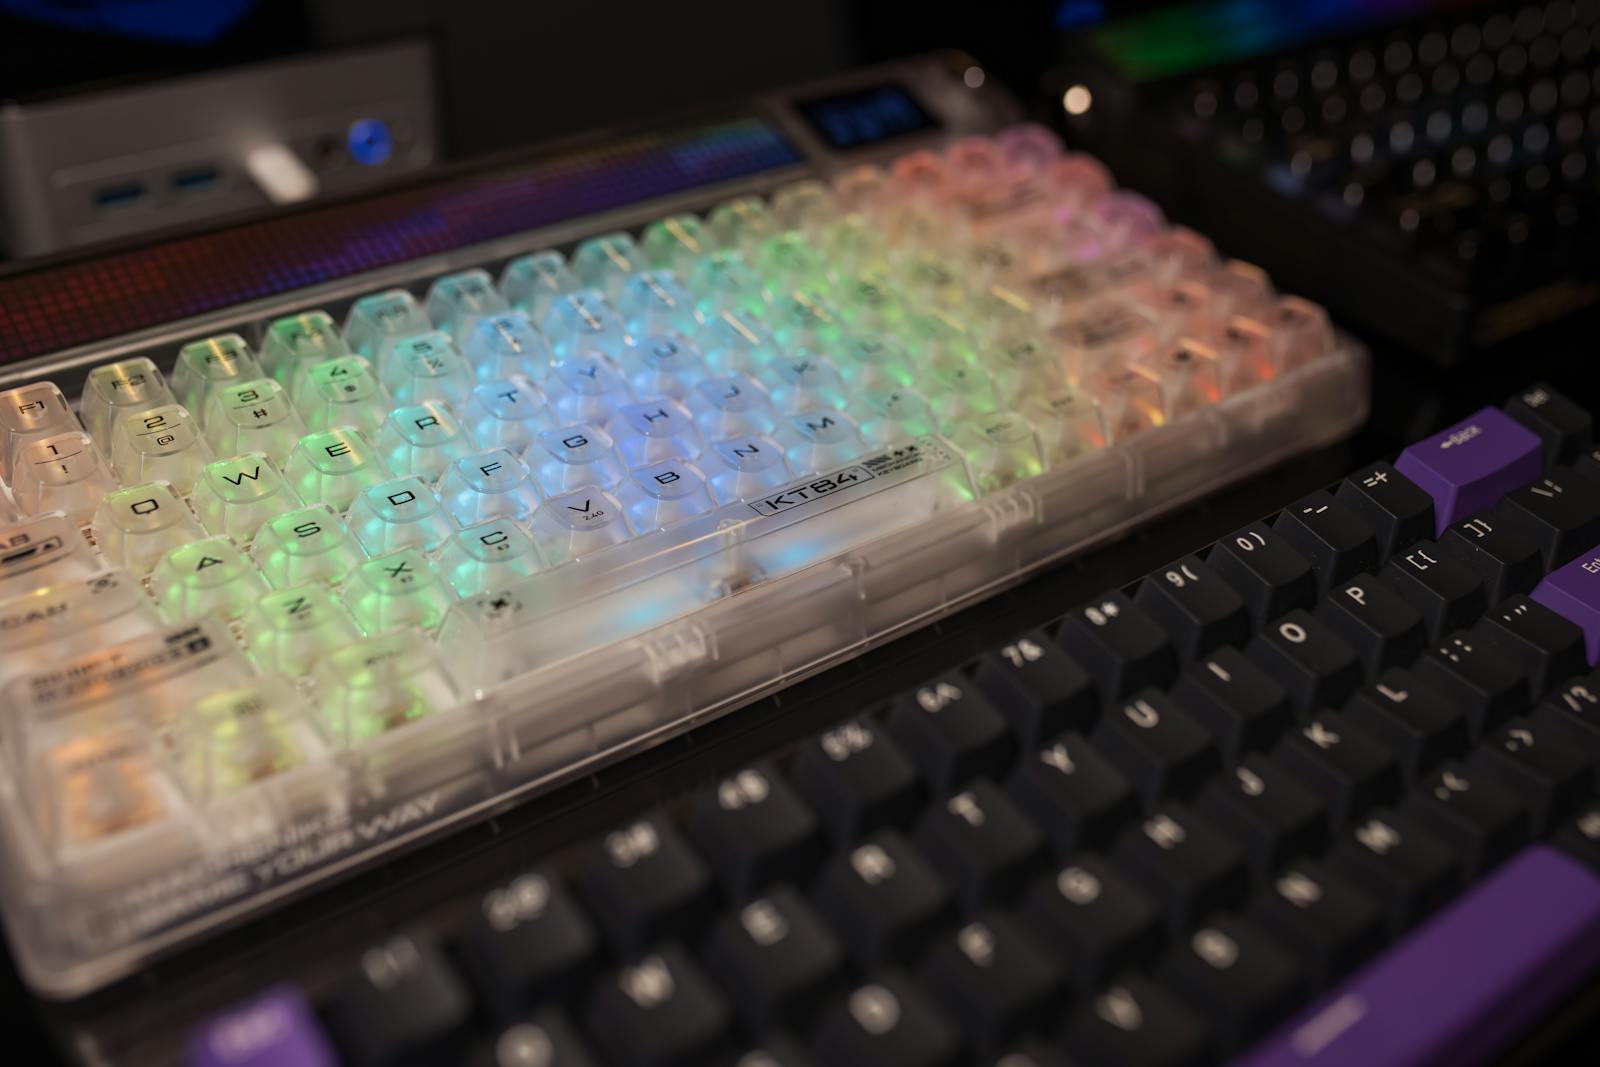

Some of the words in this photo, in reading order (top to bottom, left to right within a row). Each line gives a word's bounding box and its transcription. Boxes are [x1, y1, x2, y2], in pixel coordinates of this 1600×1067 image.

[237, 390, 259, 402] 3
[498, 389, 519, 403] T
[19, 400, 45, 415] F1
[144, 416, 166, 429] 2
[415, 415, 440, 430] R
[643, 409, 669, 424] H
[806, 416, 836, 432] M
[157, 434, 174, 446] @
[562, 435, 588, 449] G
[47, 445, 58, 455] 1
[325, 442, 351, 458] E
[733, 444, 760, 458] N
[223, 466, 260, 486] W
[480, 461, 502, 476] F
[654, 471, 680, 485] B
[387, 490, 416, 506] D
[765, 473, 858, 510] KT84
[131, 499, 160, 515] Q
[568, 499, 590, 512] V
[294, 522, 321, 538] S
[480, 531, 508, 545] C
[197, 556, 223, 571] A
[384, 561, 413, 577] X
[1345, 586, 1367, 605] P
[1376, 684, 1409, 703] L
[1123, 699, 1160, 729] U
